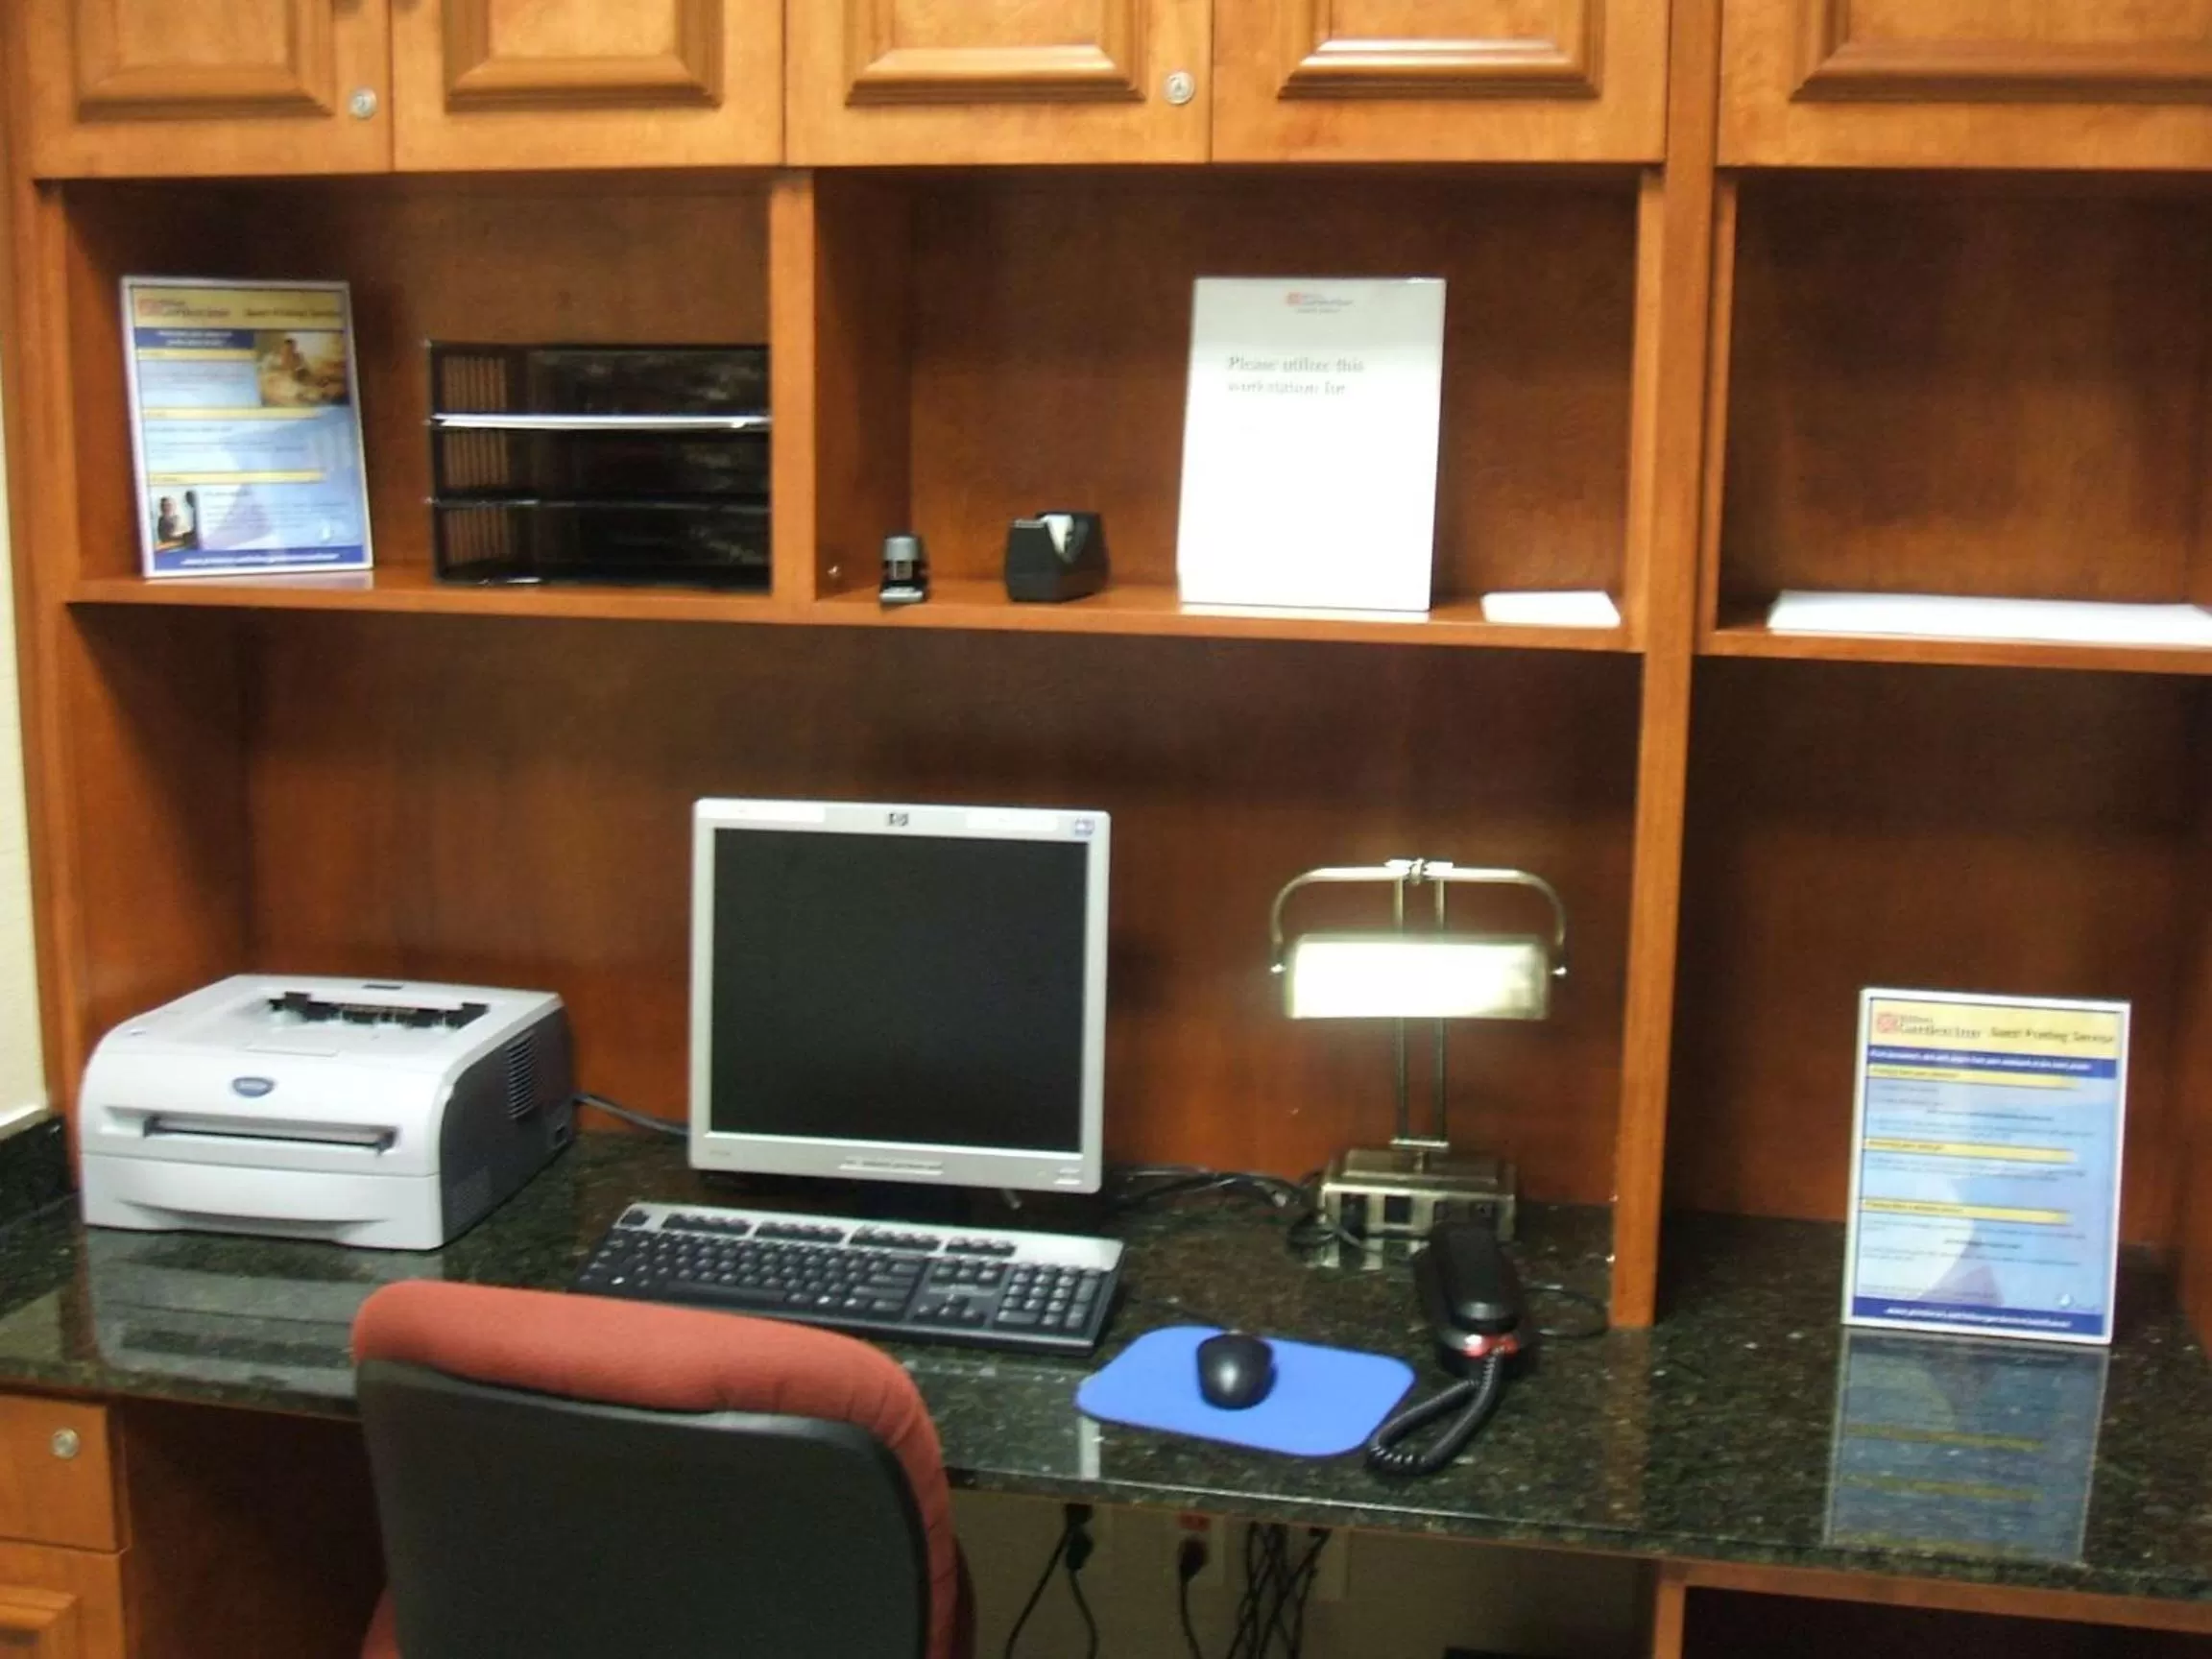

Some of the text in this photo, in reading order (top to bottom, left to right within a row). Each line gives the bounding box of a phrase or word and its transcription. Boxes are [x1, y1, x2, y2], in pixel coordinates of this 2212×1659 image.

[1227, 355, 1275, 371] Please
[1335, 356, 1364, 373] this
[1324, 380, 1347, 397] for
